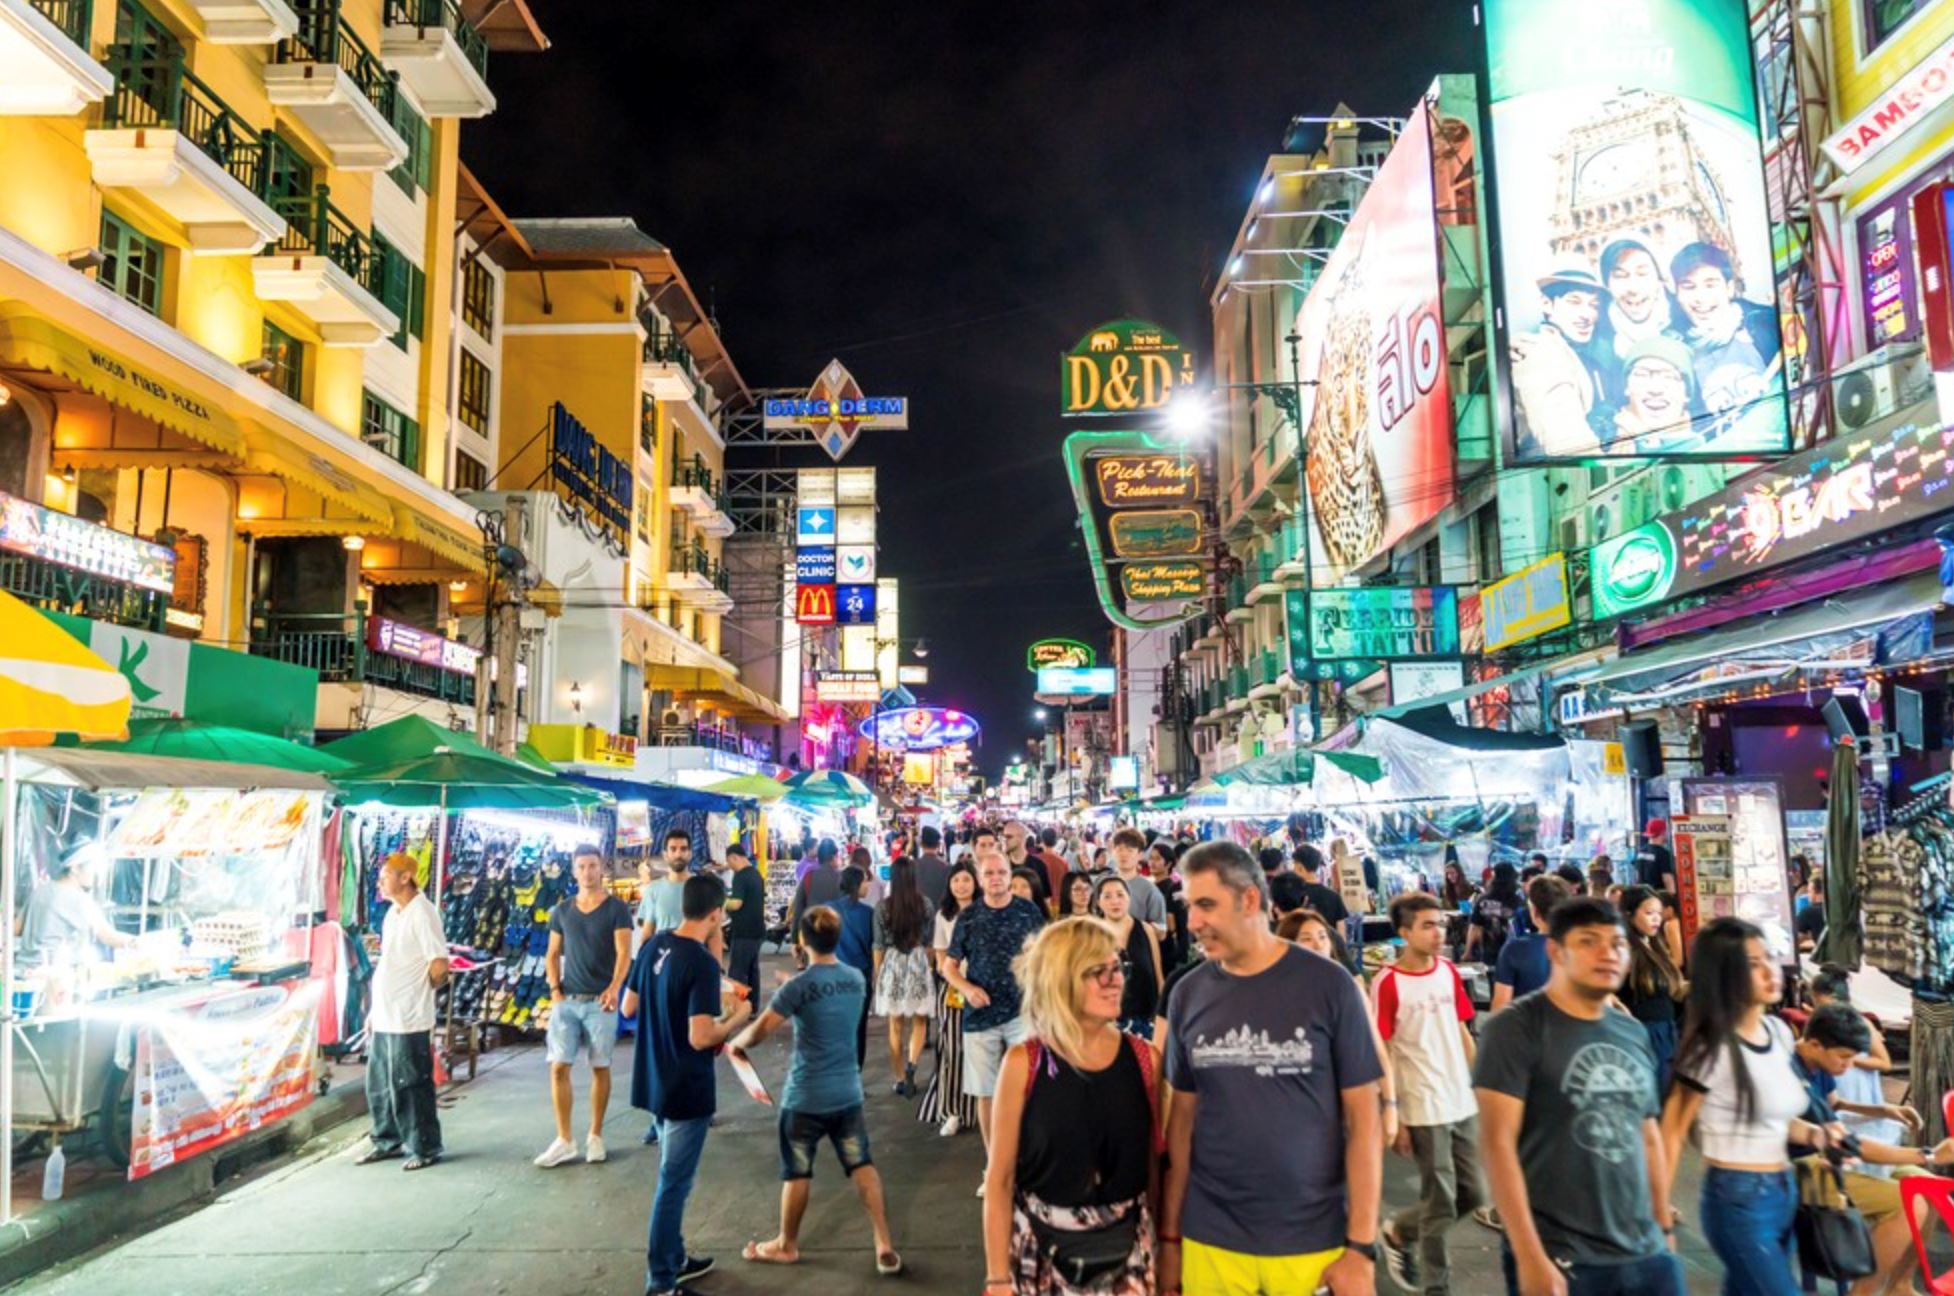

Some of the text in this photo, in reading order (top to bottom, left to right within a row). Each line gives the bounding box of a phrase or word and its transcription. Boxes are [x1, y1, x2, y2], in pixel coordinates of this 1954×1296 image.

[1836, 49, 1954, 158] BAMBO
[87, 348, 211, 421] WOOD FIRED PIZZA
[840, 399, 904, 415] DERM
[1066, 353, 1174, 411] D&D
[1780, 461, 1875, 540] BAR
[797, 553, 835, 563] DOCTOR
[797, 566, 835, 577] CLINIC
